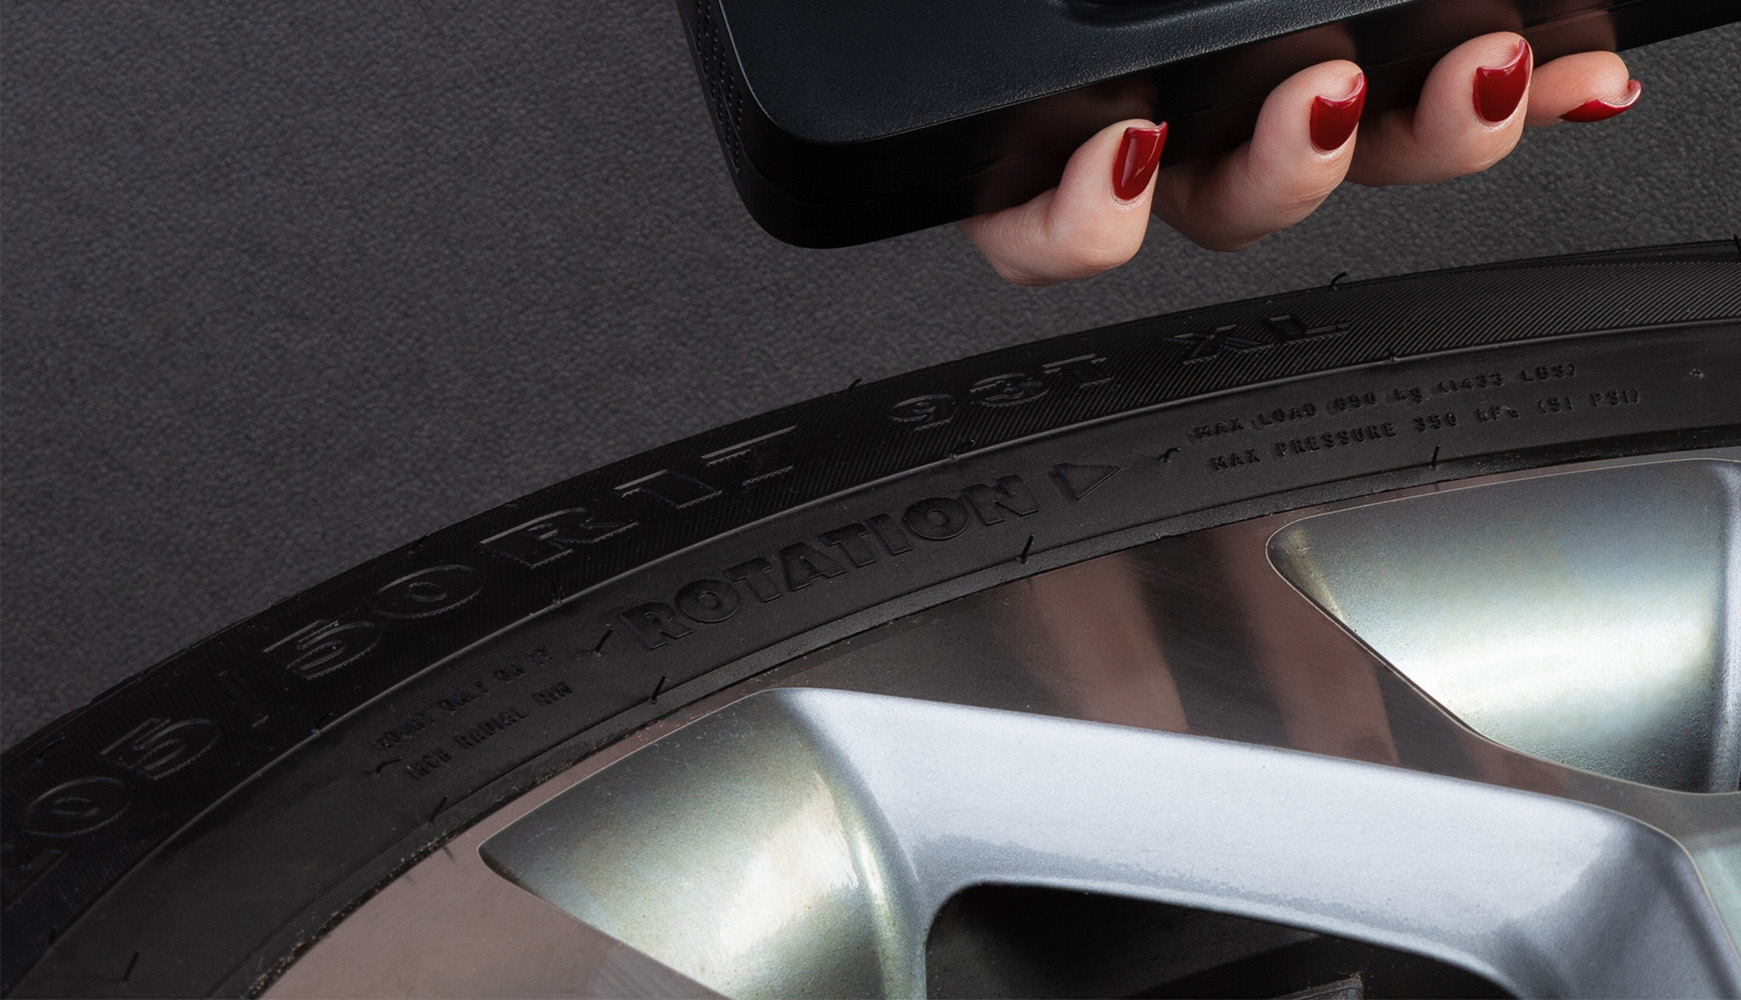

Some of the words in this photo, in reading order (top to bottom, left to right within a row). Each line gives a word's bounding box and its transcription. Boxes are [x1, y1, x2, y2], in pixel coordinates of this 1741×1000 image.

[1164, 314, 1352, 366] XL
[1194, 418, 1244, 439] MAX
[1257, 402, 1317, 426] LOAD
[1209, 448, 1260, 471] MAX
[1275, 422, 1397, 457] PRESSURE
[1413, 412, 1457, 432] 350
[618, 473, 1040, 651] ROTATION
[454, 706, 529, 750] RADIAL
